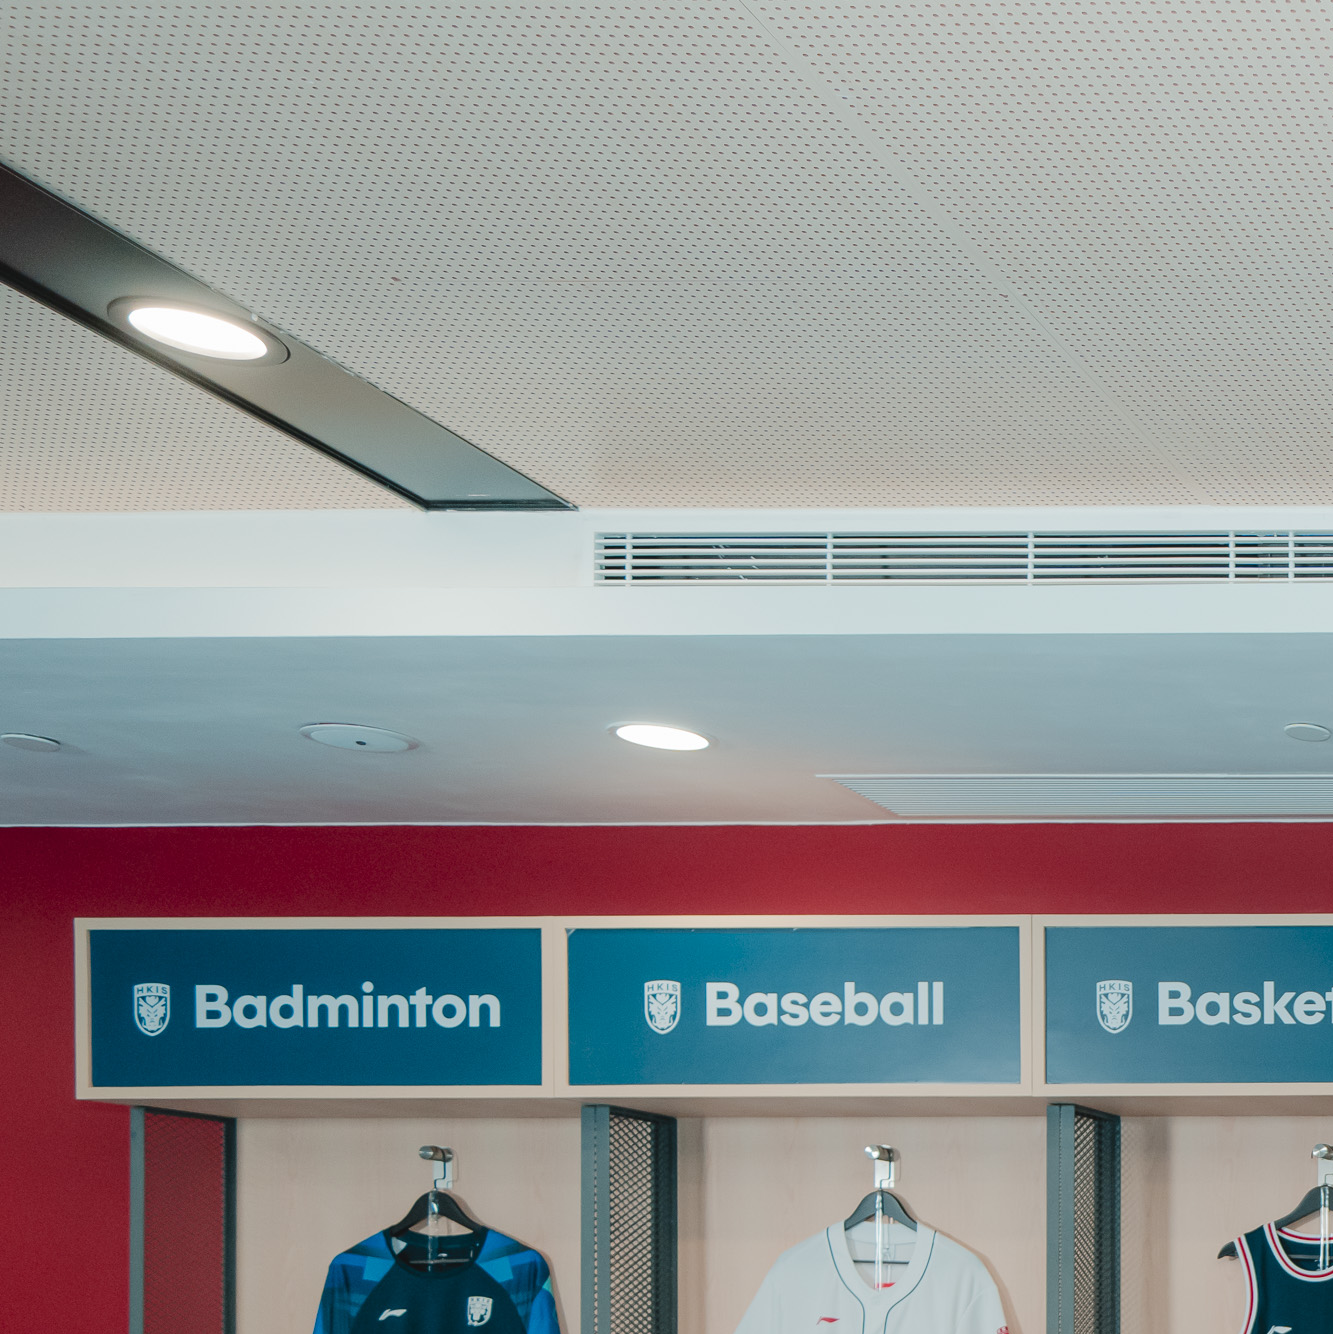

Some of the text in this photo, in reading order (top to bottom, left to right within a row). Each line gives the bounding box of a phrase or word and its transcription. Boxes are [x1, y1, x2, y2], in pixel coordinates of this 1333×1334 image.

[136, 986, 168, 995] HKIS
[647, 983, 678, 992] HKIS
[1099, 983, 1130, 992] HKIS
[195, 981, 501, 1029] Badminton
[705, 981, 944, 1027] Baseball
